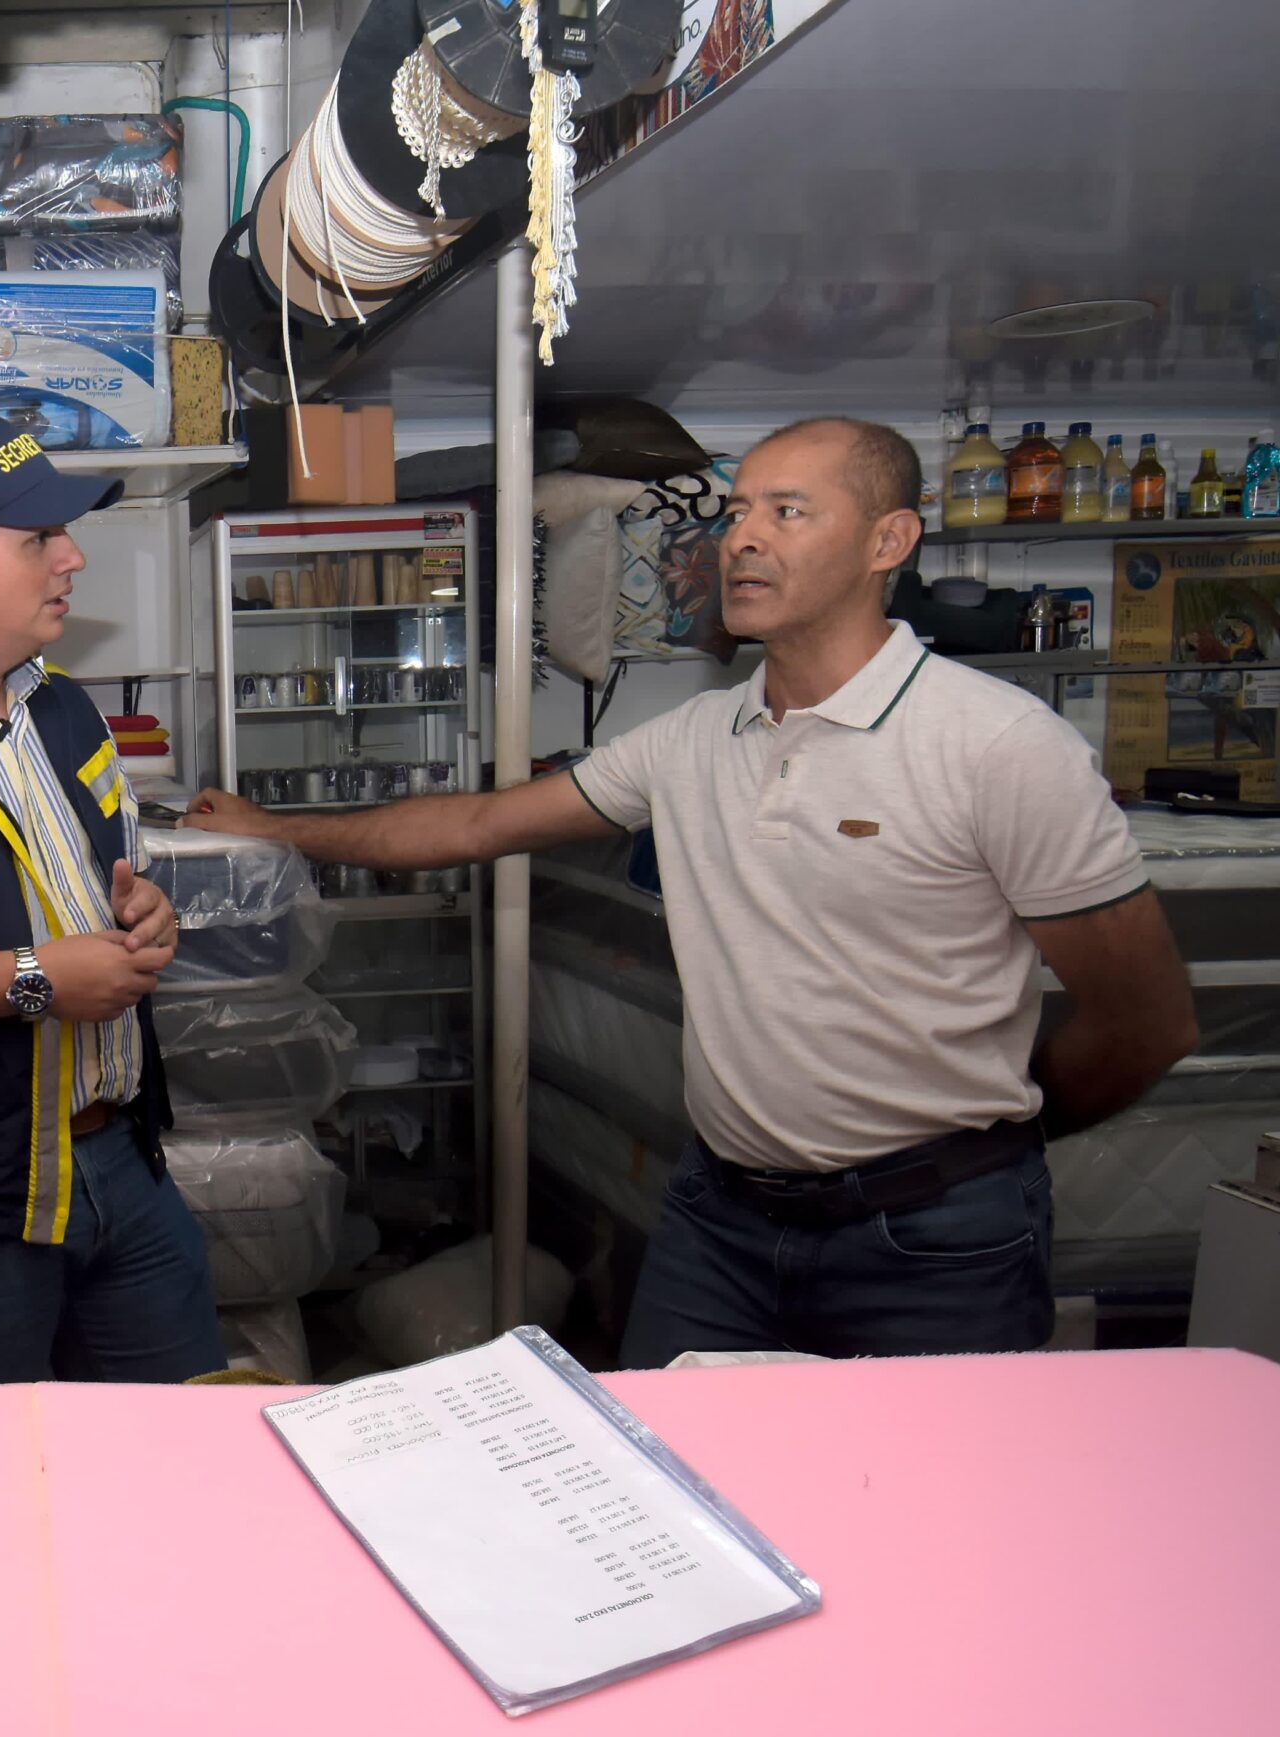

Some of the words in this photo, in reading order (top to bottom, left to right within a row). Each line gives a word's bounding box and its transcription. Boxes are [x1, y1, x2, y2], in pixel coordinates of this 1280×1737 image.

[45, 376, 123, 391] SONAR
[1168, 551, 1225, 569] Textiles
[541, 1443, 575, 1457] COLCHONETA
[608, 1593, 653, 1611] COLCHONETAS
[575, 1613, 594, 1623] 2.025
[593, 1608, 608, 1616] EKO
